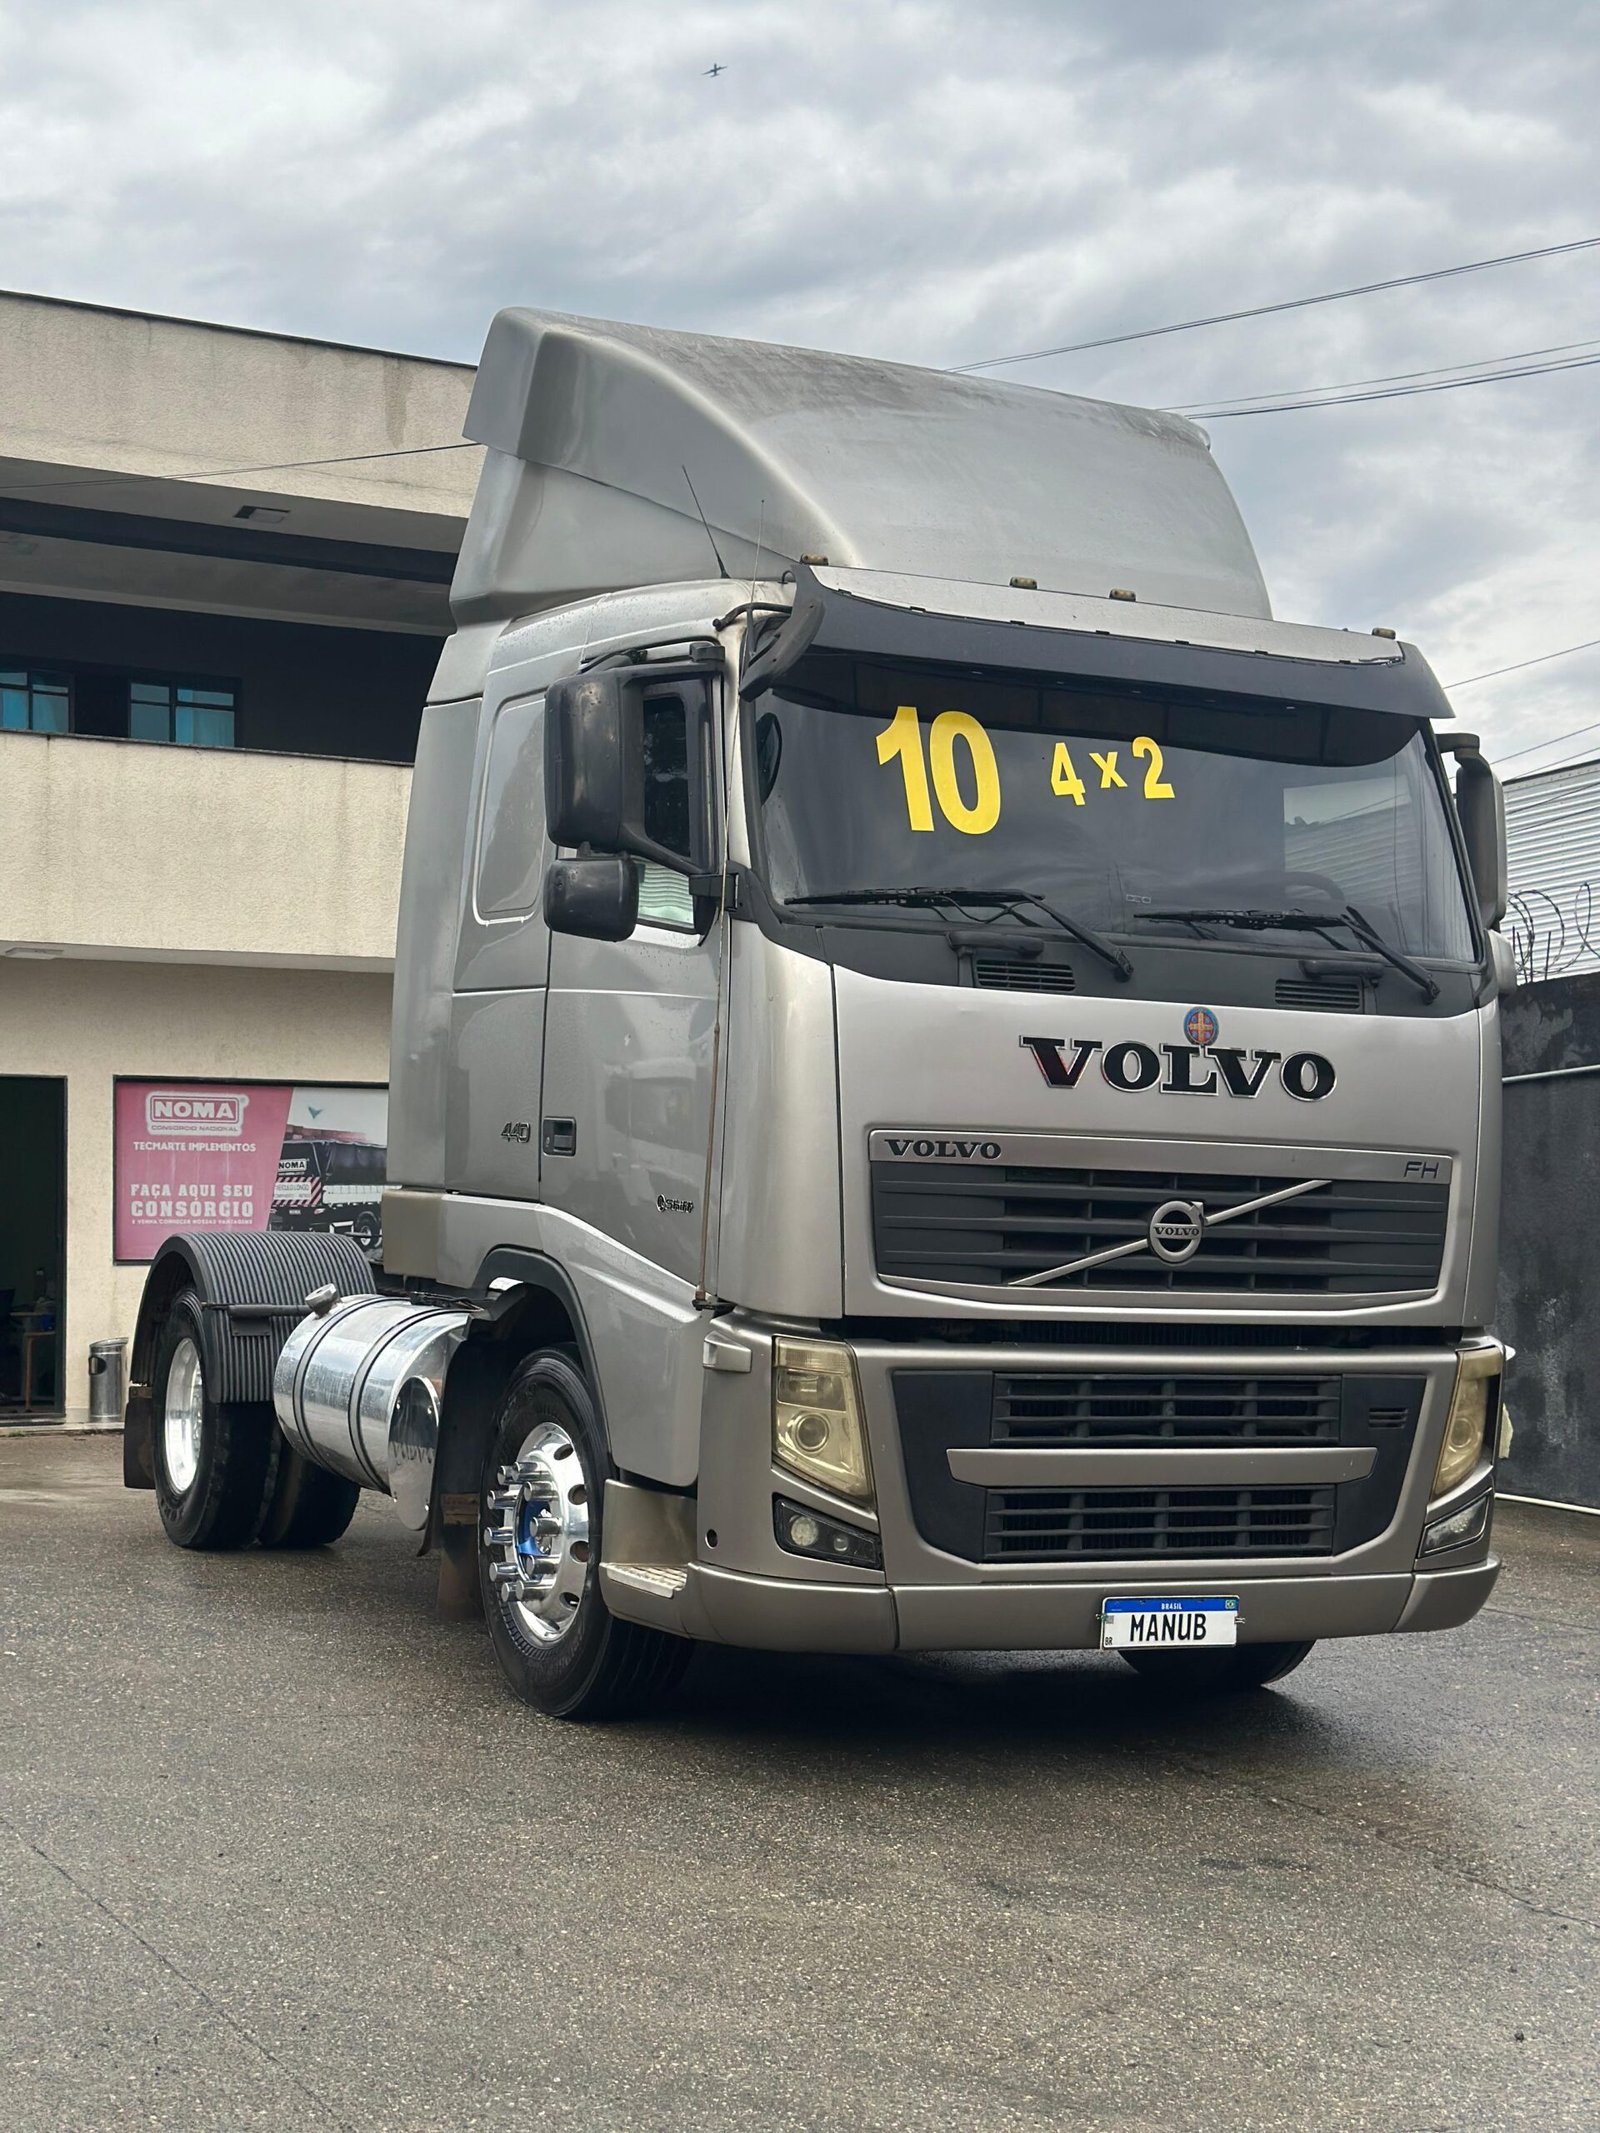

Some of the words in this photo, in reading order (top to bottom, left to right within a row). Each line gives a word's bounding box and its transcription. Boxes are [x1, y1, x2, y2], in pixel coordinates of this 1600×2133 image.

[875, 706, 1001, 835] 10
[1051, 742, 1086, 806] 4
[1132, 736, 1176, 799] 2
[1019, 1035, 1337, 1102] VOLVO
[154, 1100, 235, 1118] NOMA
[501, 1122, 531, 1143] 440
[188, 1142, 257, 1152] IMPLEMENTOS
[884, 1139, 1002, 1160] VOLVO
[278, 1161, 305, 1169] NOMA
[1403, 1161, 1439, 1179] FH
[130, 1184, 171, 1199] FAÇA
[178, 1184, 216, 1198] AQUI
[222, 1185, 253, 1197] SEU
[1154, 1227, 1200, 1236] VOLVO
[1161, 1602, 1182, 1610] BRASIL
[1130, 1613, 1206, 1641] MANUB
[1105, 1636, 1113, 1645] BR
